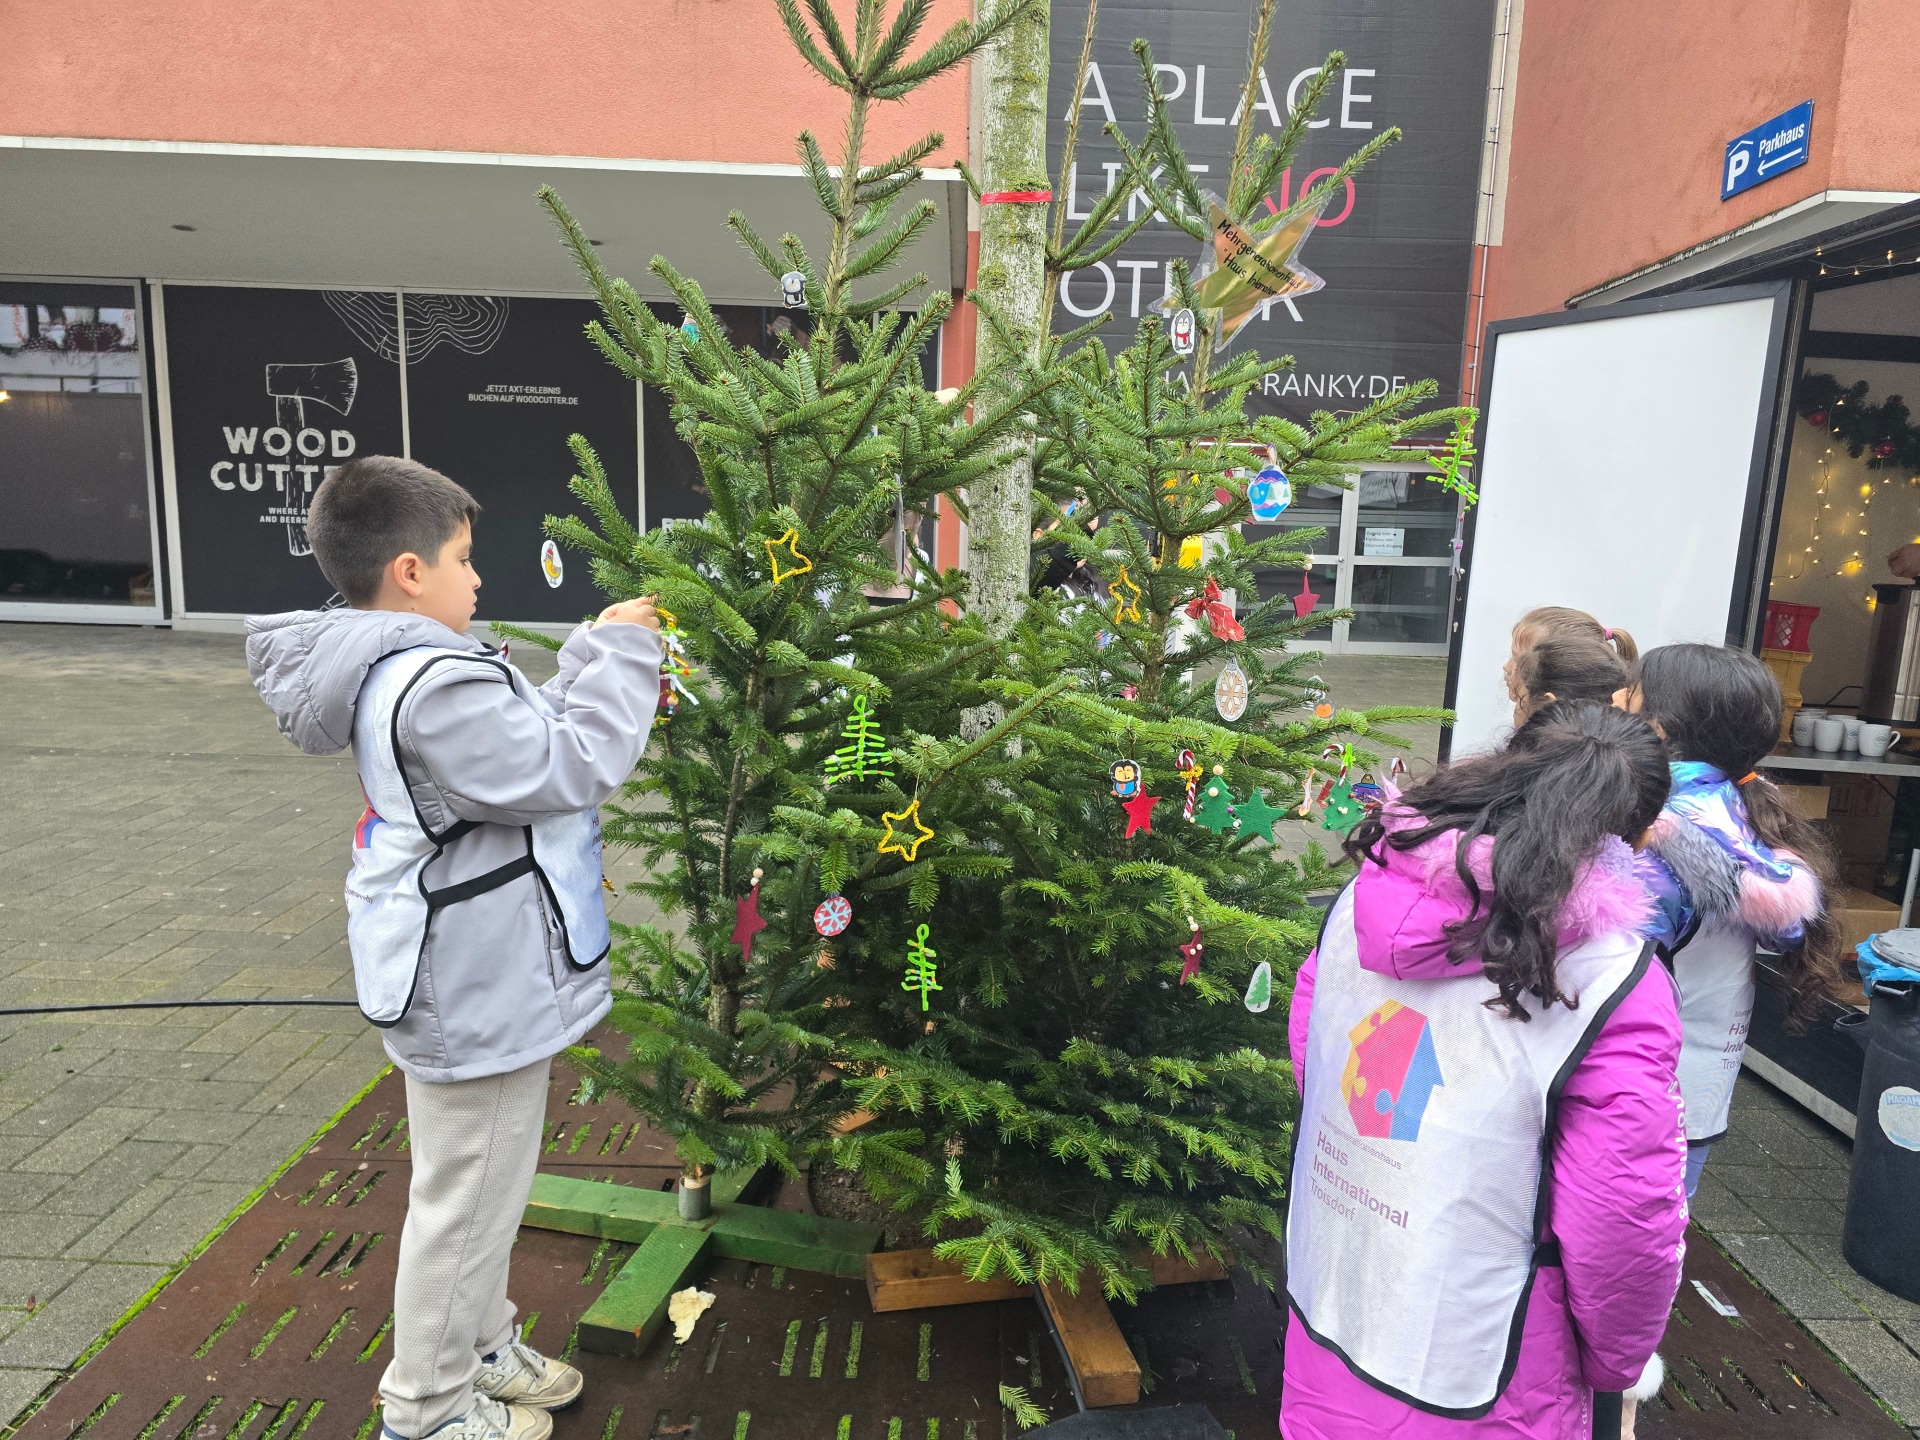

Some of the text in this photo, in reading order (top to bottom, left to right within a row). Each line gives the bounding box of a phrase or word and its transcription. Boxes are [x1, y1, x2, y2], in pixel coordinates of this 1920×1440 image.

[1147, 63, 1376, 129] PLACE
[1758, 123, 1805, 158] Parkhaus
[1726, 150, 1750, 192] P
[468, 393, 579, 405] BUCHEN AUF WOODCUTTER.DE
[485, 384, 562, 395] JETZT AXT-ERLEBNIS
[222, 426, 356, 458] WOOD
[259, 515, 278, 523] AND
[268, 507, 310, 516] WHERE A
[1317, 1130, 1349, 1167] Haus
[1310, 1175, 1357, 1221] Troisdorf
[1313, 1154, 1409, 1229] International
